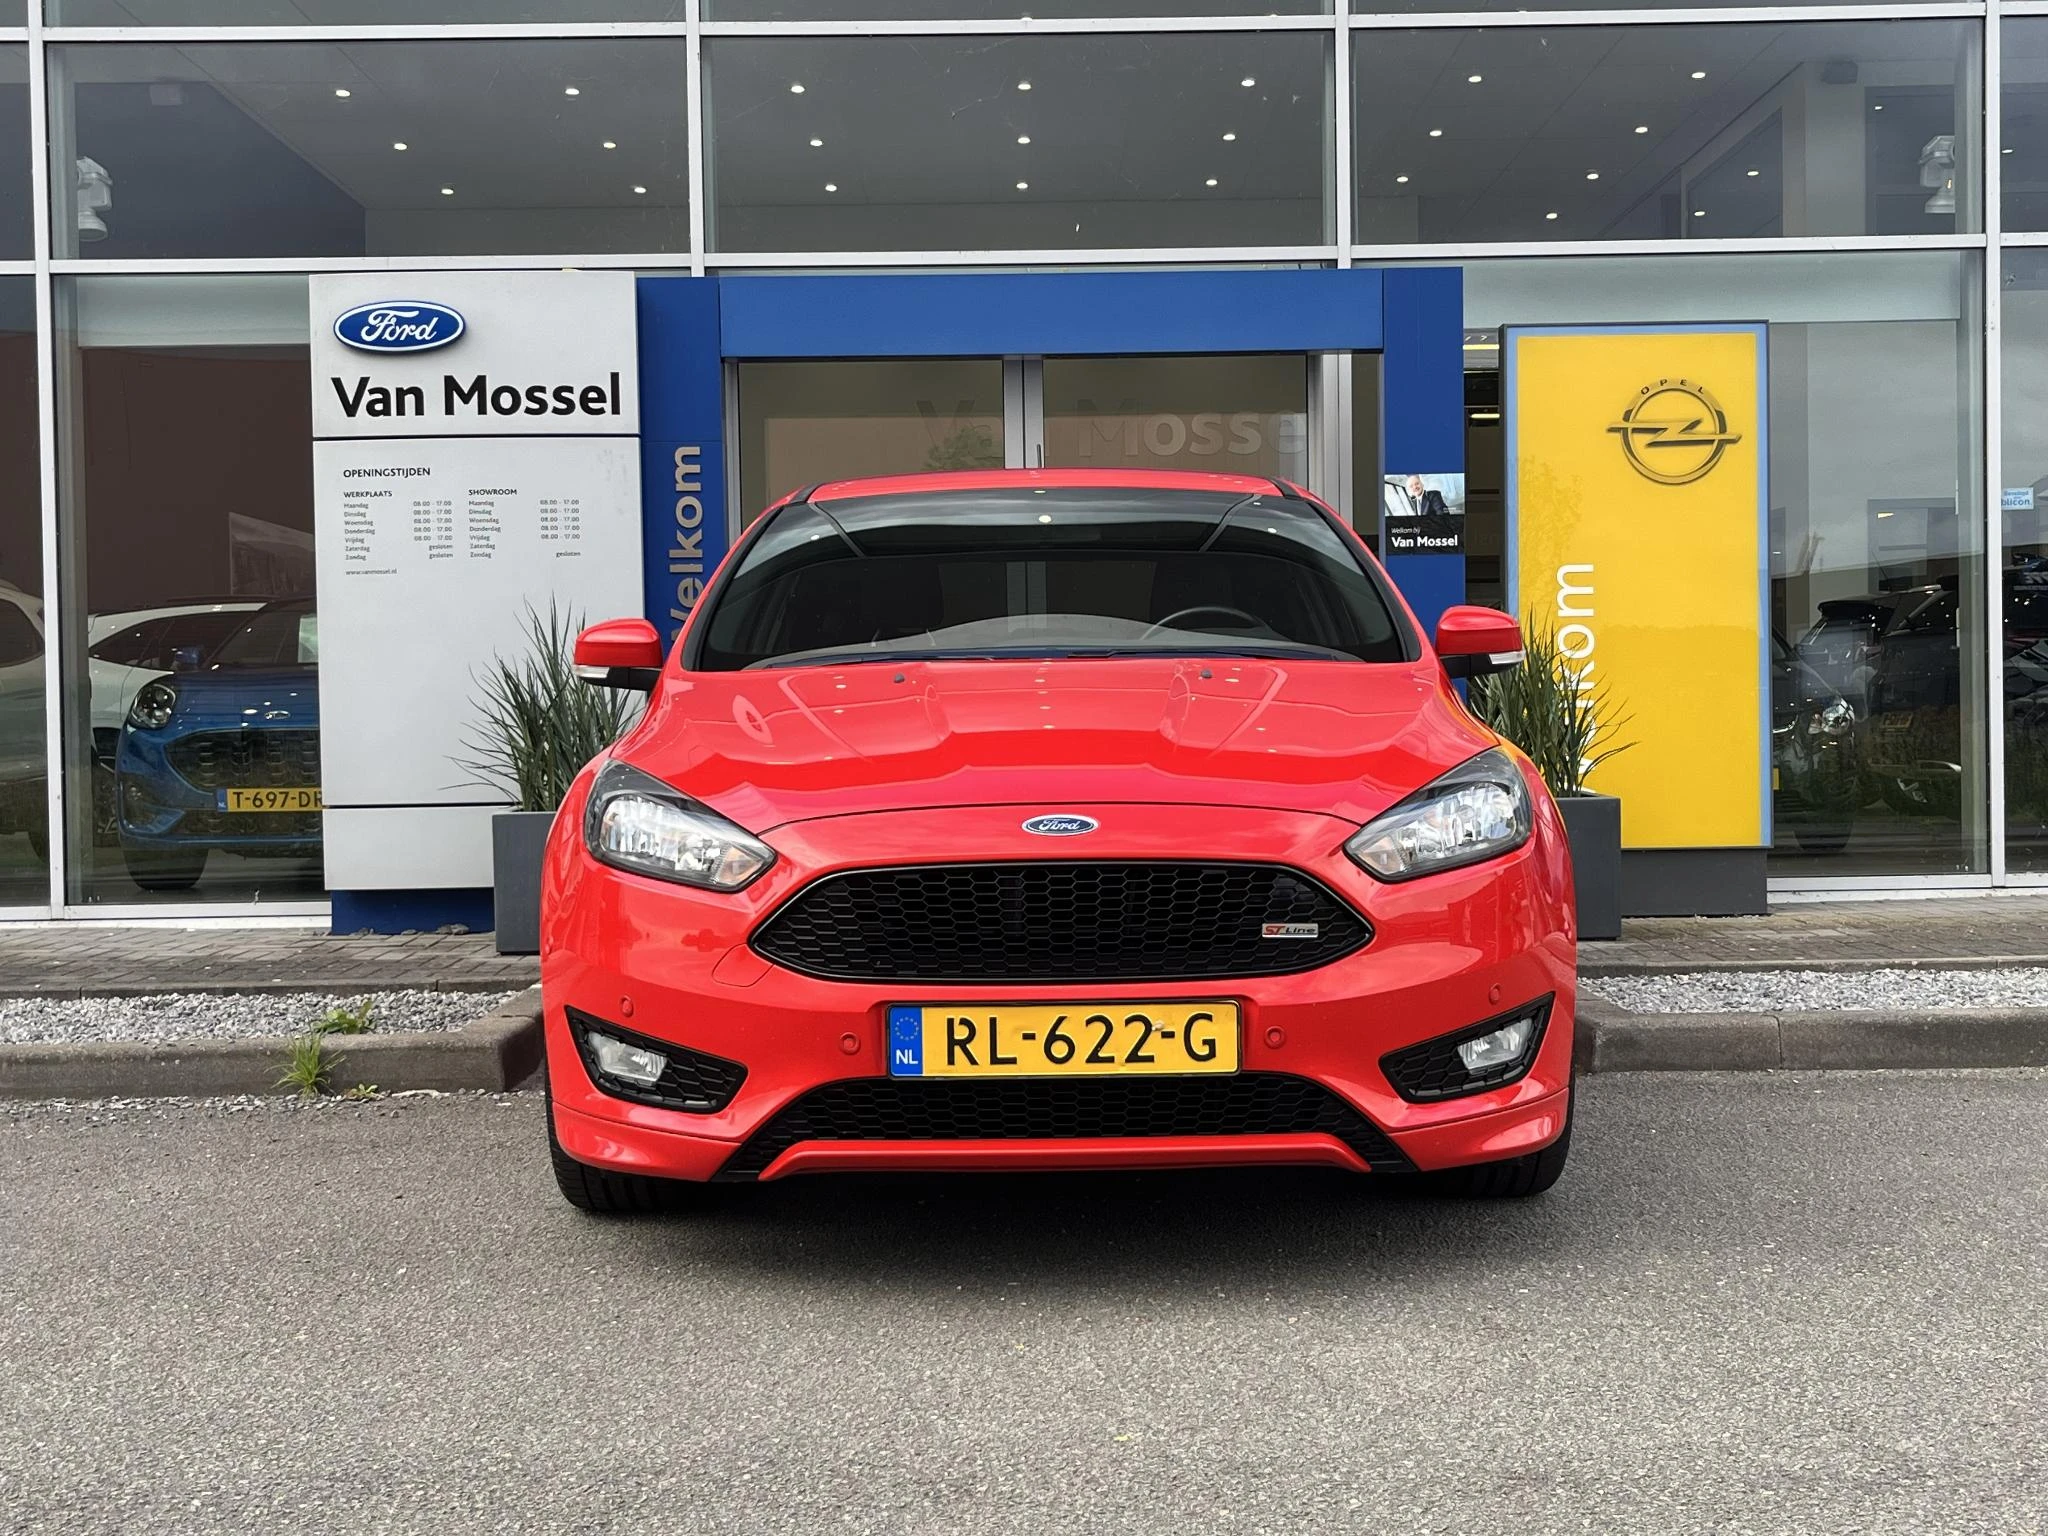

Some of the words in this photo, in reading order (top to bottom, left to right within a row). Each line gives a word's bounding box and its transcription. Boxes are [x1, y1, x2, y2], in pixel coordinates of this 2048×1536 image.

[361, 309, 438, 342] Ford
[1640, 378, 1705, 395] OPEL
[331, 376, 425, 418] Van
[443, 372, 621, 416] Mossel
[343, 467, 431, 479] OPENINGSTIJDEN
[343, 490, 393, 498] WERKPLAATS
[468, 488, 518, 496] SHOWROOM
[1391, 536, 1414, 548] Van
[1417, 534, 1458, 547] Mossel
[1038, 818, 1081, 831] Ford
[1265, 925, 1286, 935] ST
[946, 1012, 1217, 1067] RL-622-G
[895, 1049, 918, 1065] NL
